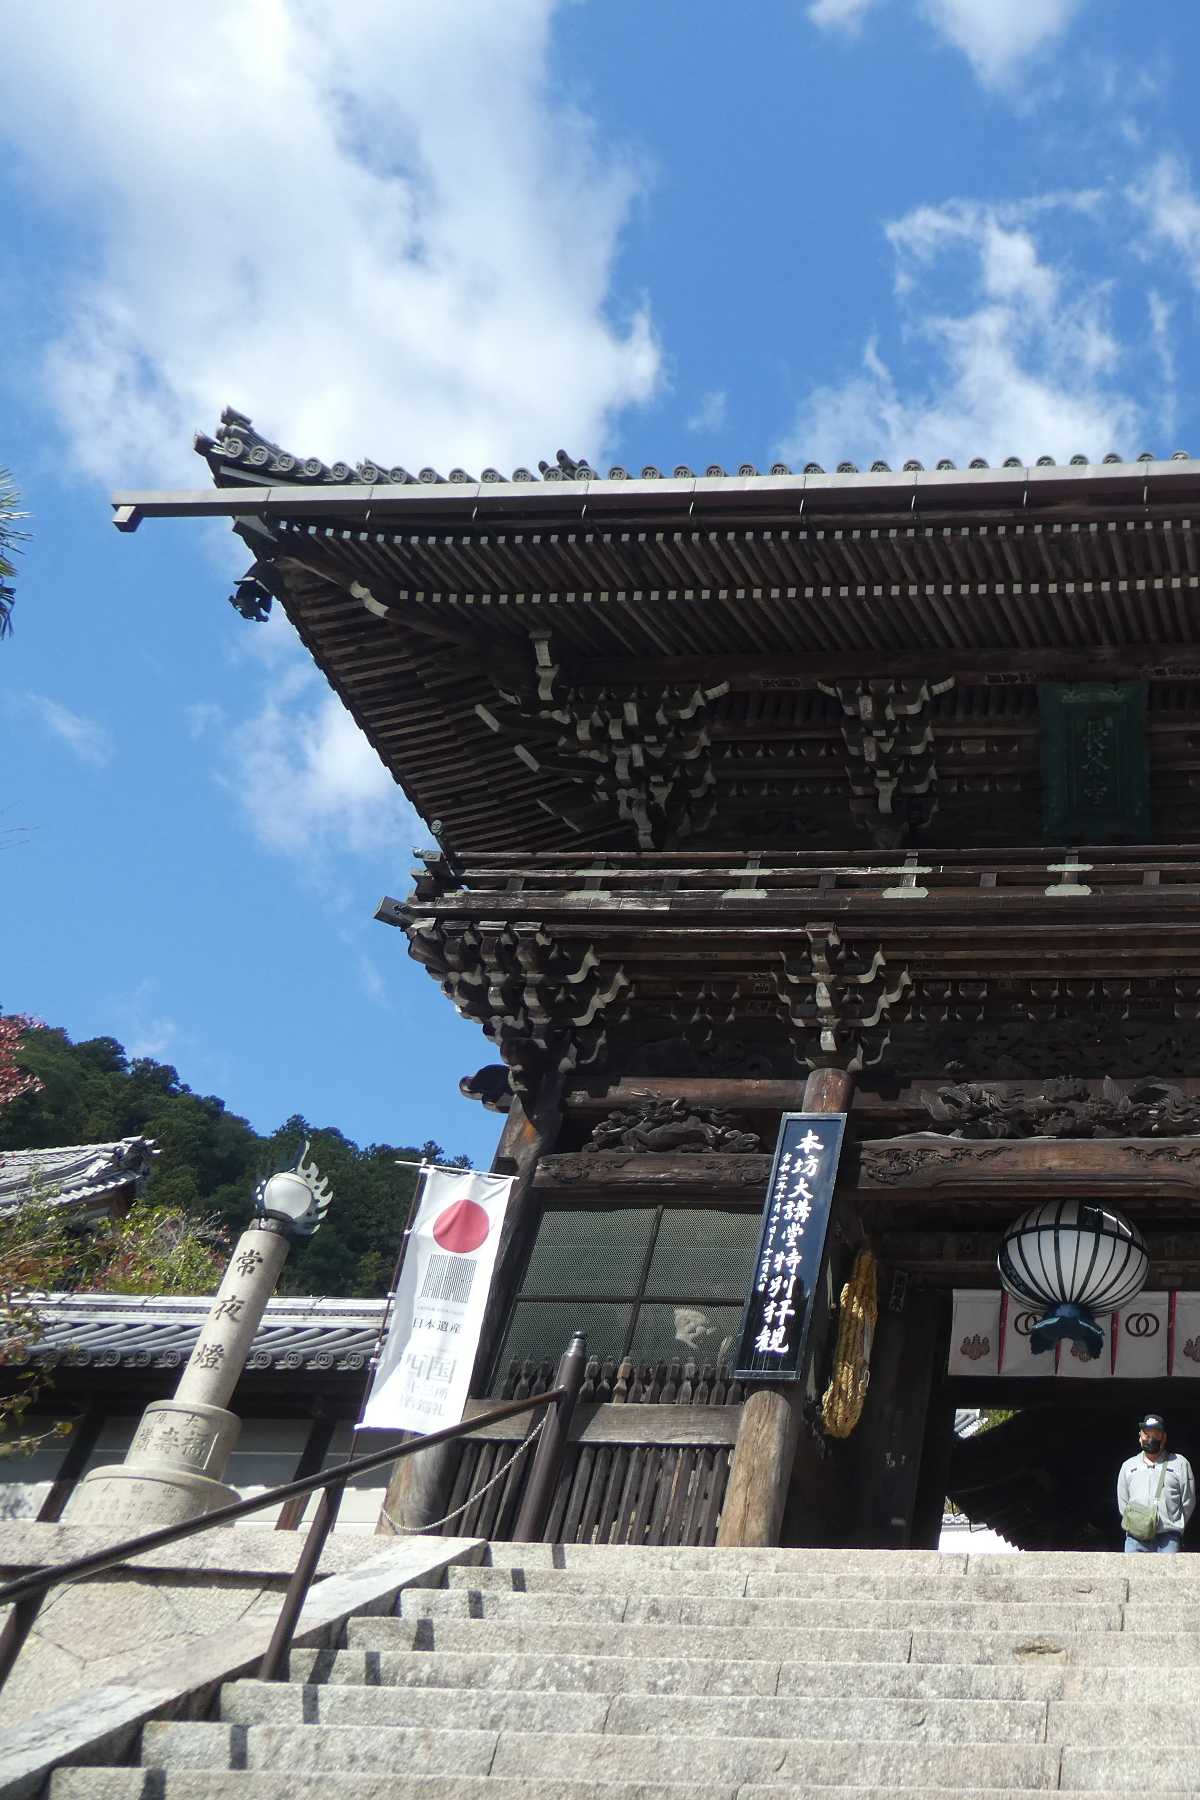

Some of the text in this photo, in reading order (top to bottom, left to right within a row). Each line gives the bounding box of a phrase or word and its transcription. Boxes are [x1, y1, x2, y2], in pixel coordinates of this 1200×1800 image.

[754, 1128, 824, 1353] 本坊大講堂特別拝観
[193, 1249, 264, 1373] 常夜燈
[411, 1317, 463, 1336] 日本遺産
